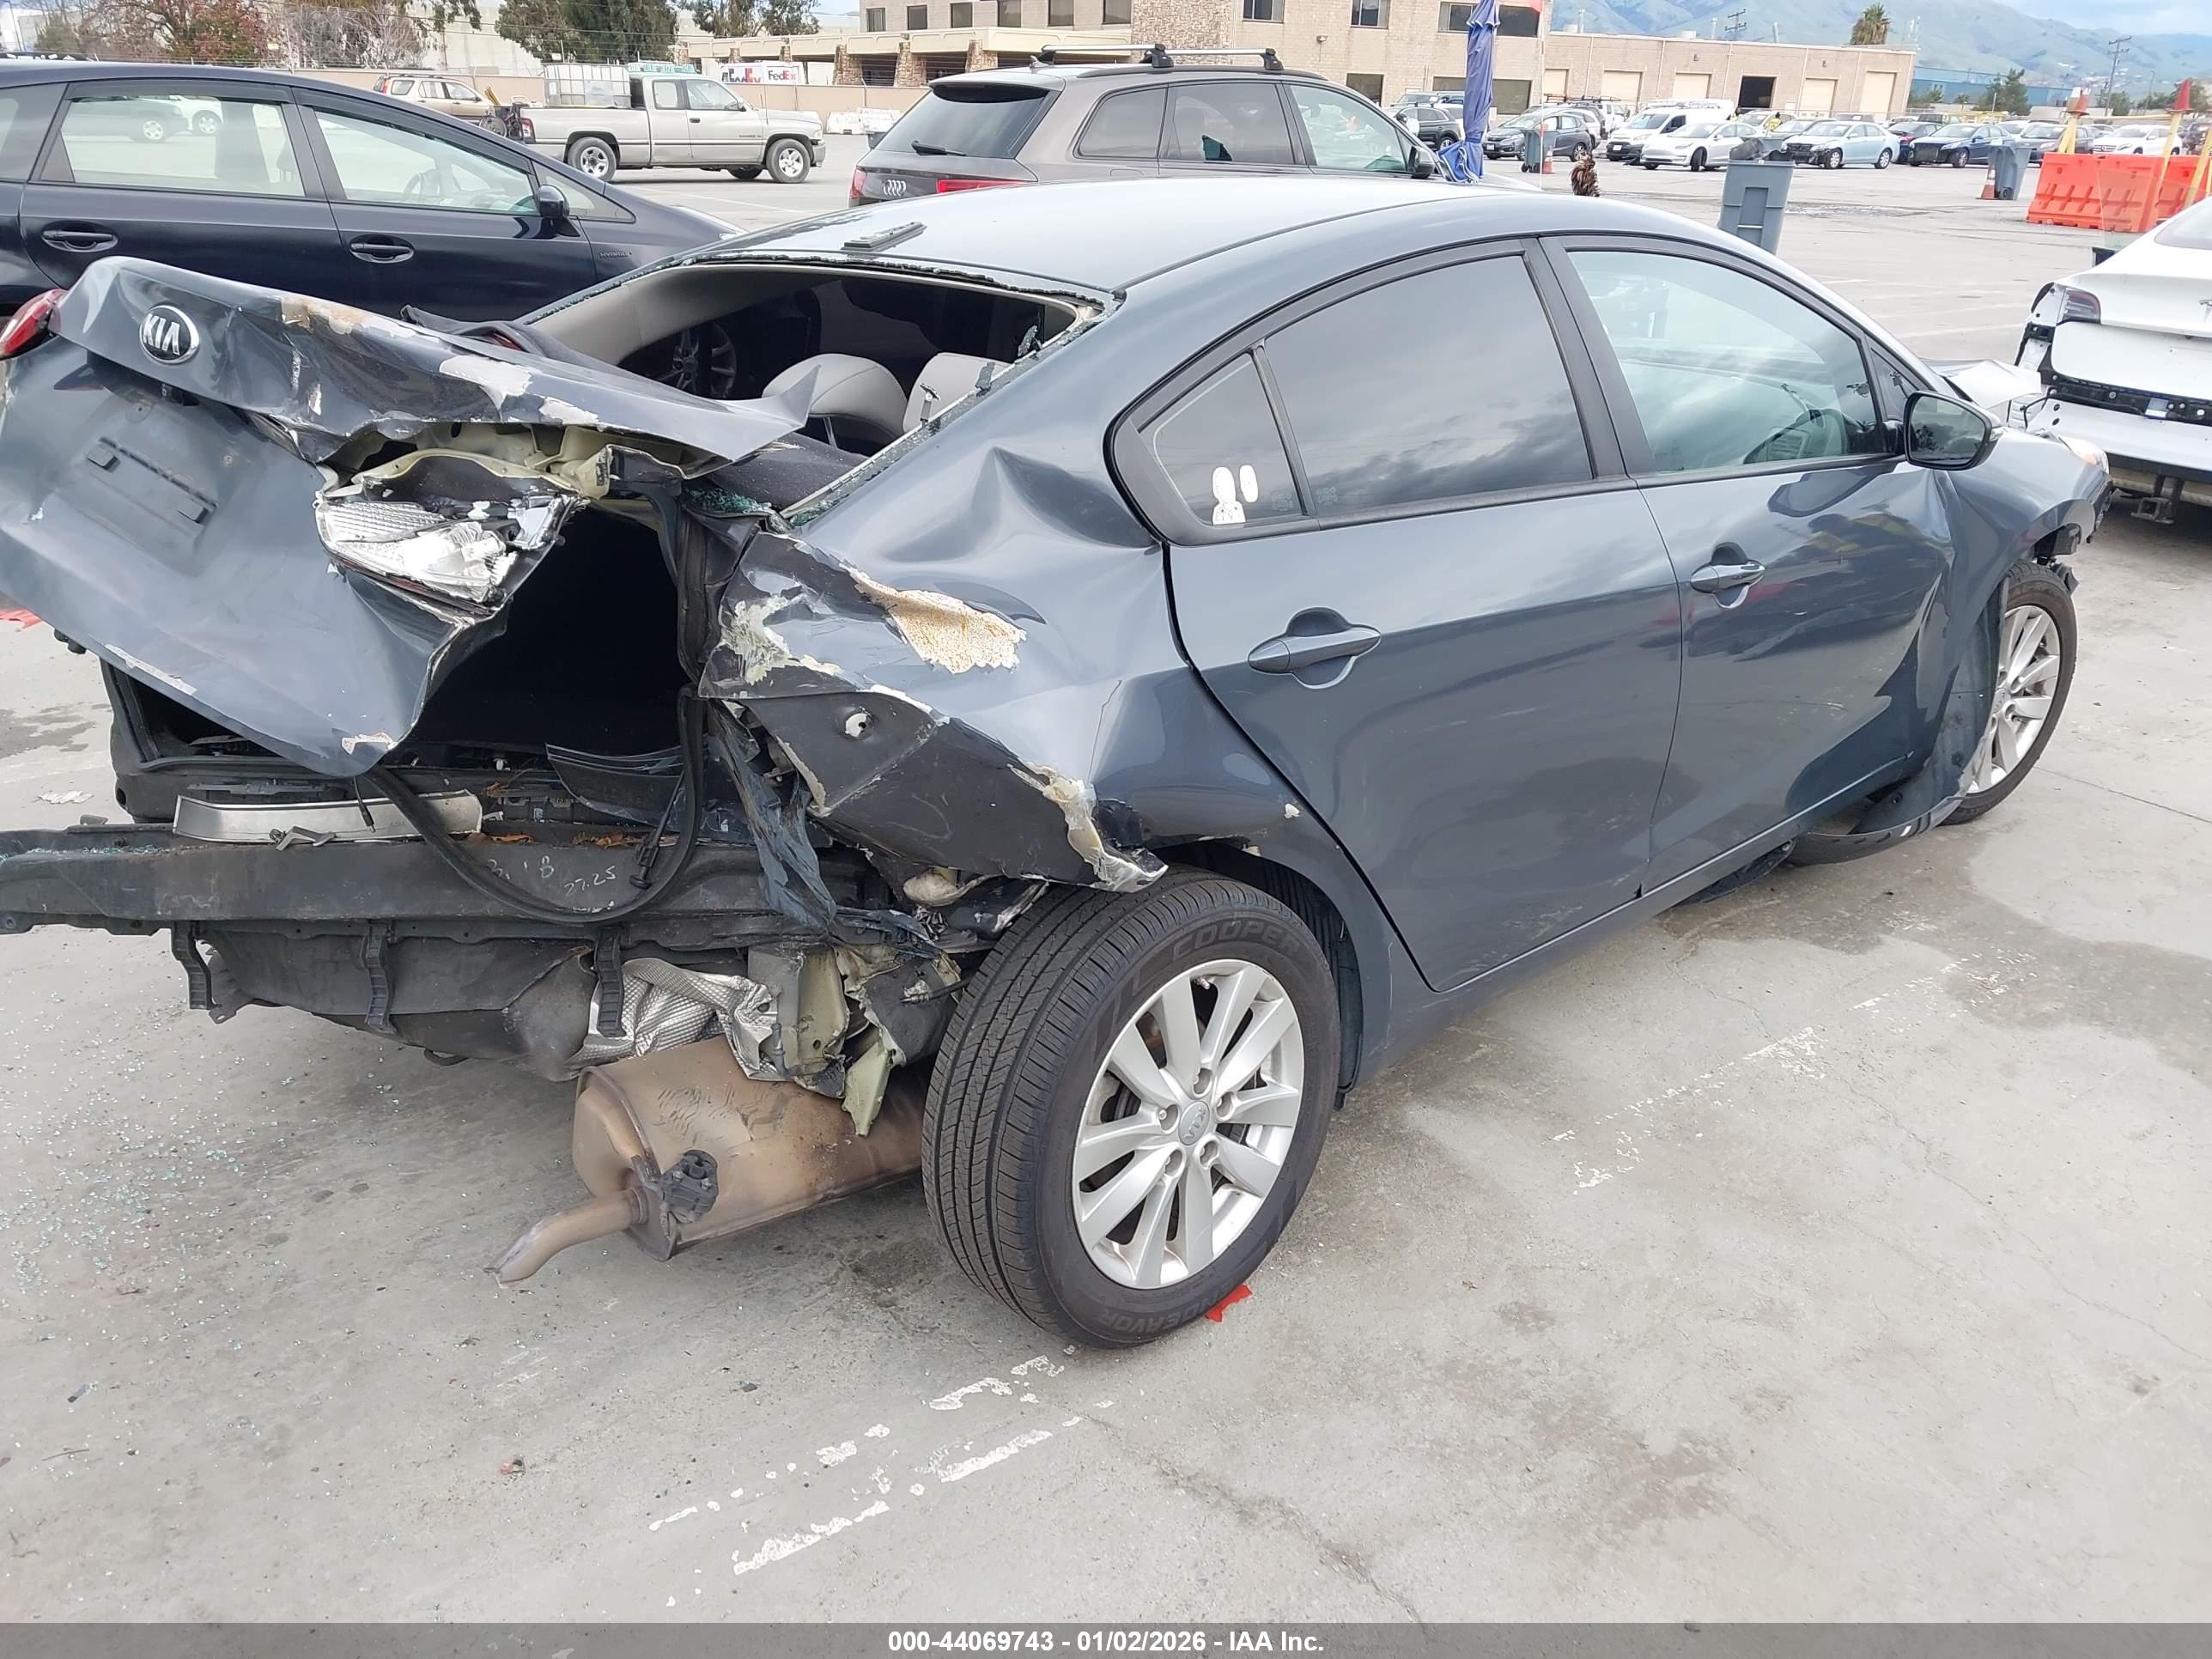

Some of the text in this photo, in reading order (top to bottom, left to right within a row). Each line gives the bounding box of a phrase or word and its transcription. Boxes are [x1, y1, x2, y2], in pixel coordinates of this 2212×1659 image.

[768, 70, 797, 81] FedEx
[143, 313, 180, 356] KIA
[1172, 921, 1301, 961] COOPER
[1185, 1106, 1206, 1139] KIA
